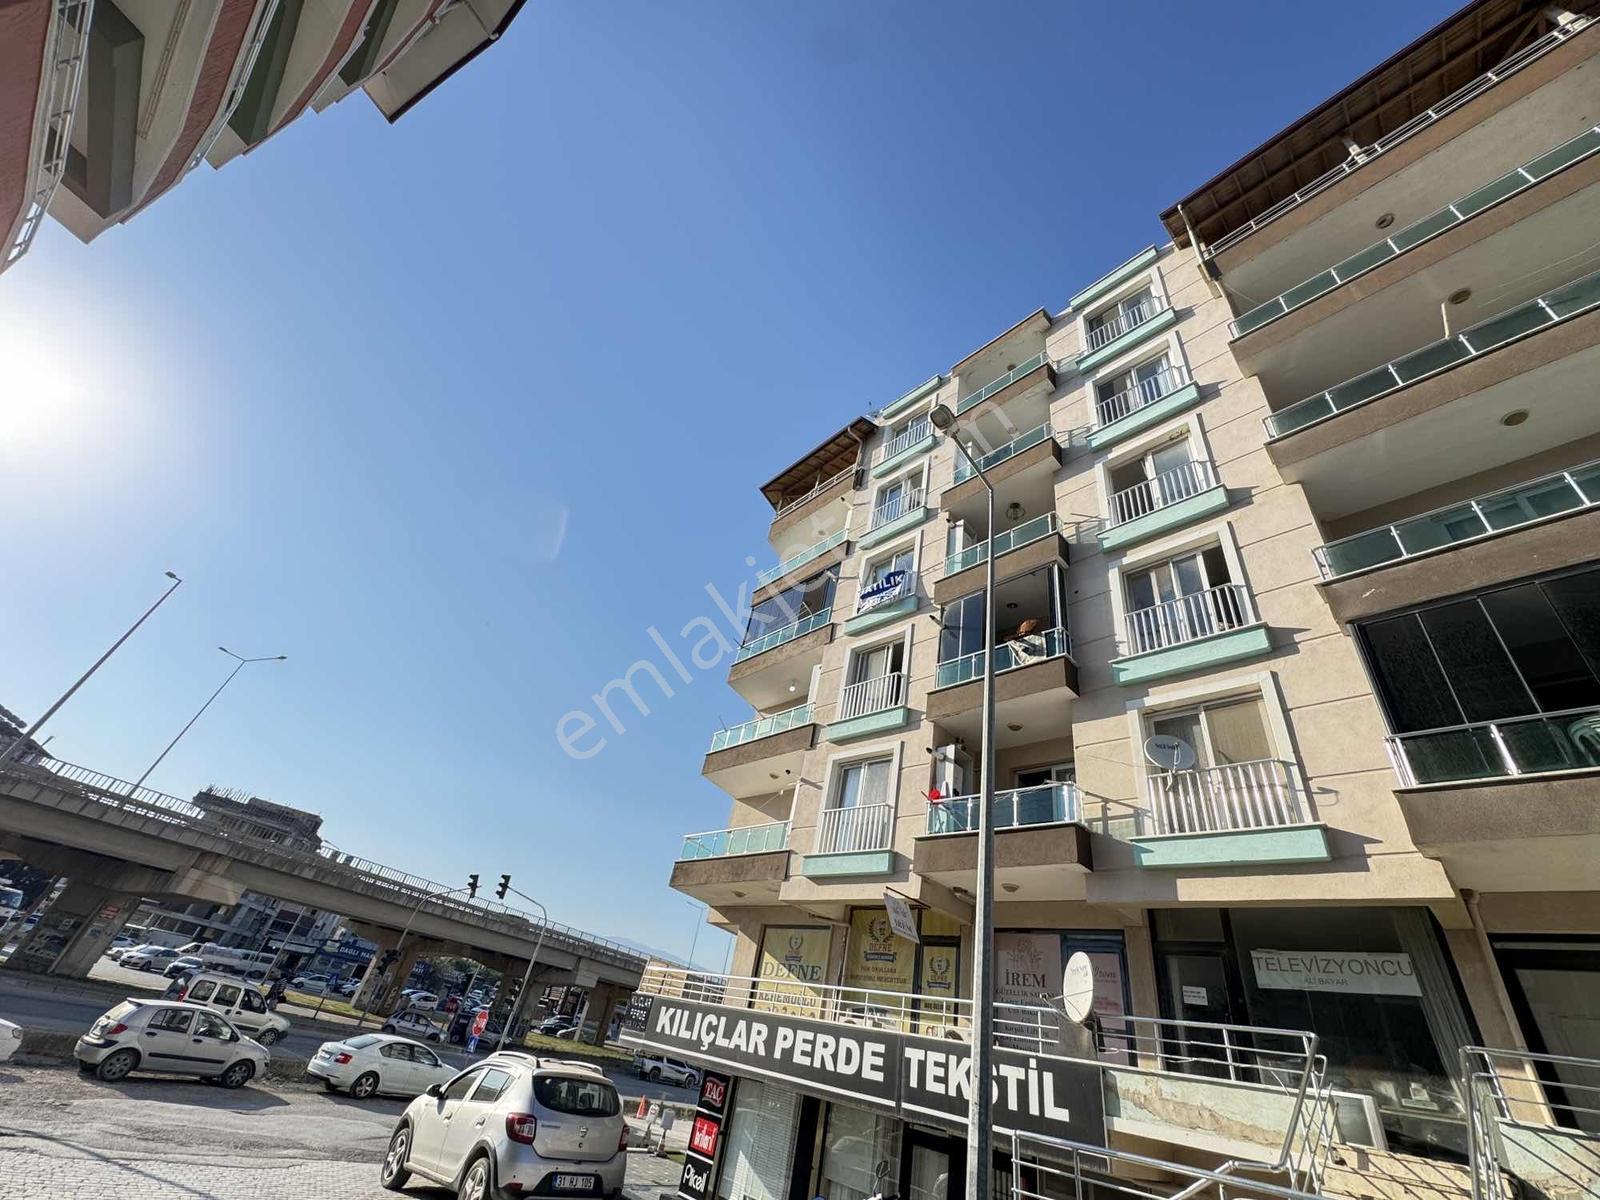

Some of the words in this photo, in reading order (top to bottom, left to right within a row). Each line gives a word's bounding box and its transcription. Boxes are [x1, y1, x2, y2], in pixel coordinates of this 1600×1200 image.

[763, 962, 822, 981] DEFNE
[1253, 956, 1414, 977] TELEVİZYONCU
[1005, 968, 1047, 989] İREM
[656, 1006, 769, 1051] KILIÇLAR
[773, 1026, 886, 1083] PERDE
[705, 1082, 724, 1103] TAÇ
[557, 1175, 566, 1188] 31
[581, 1176, 593, 1189] 105
